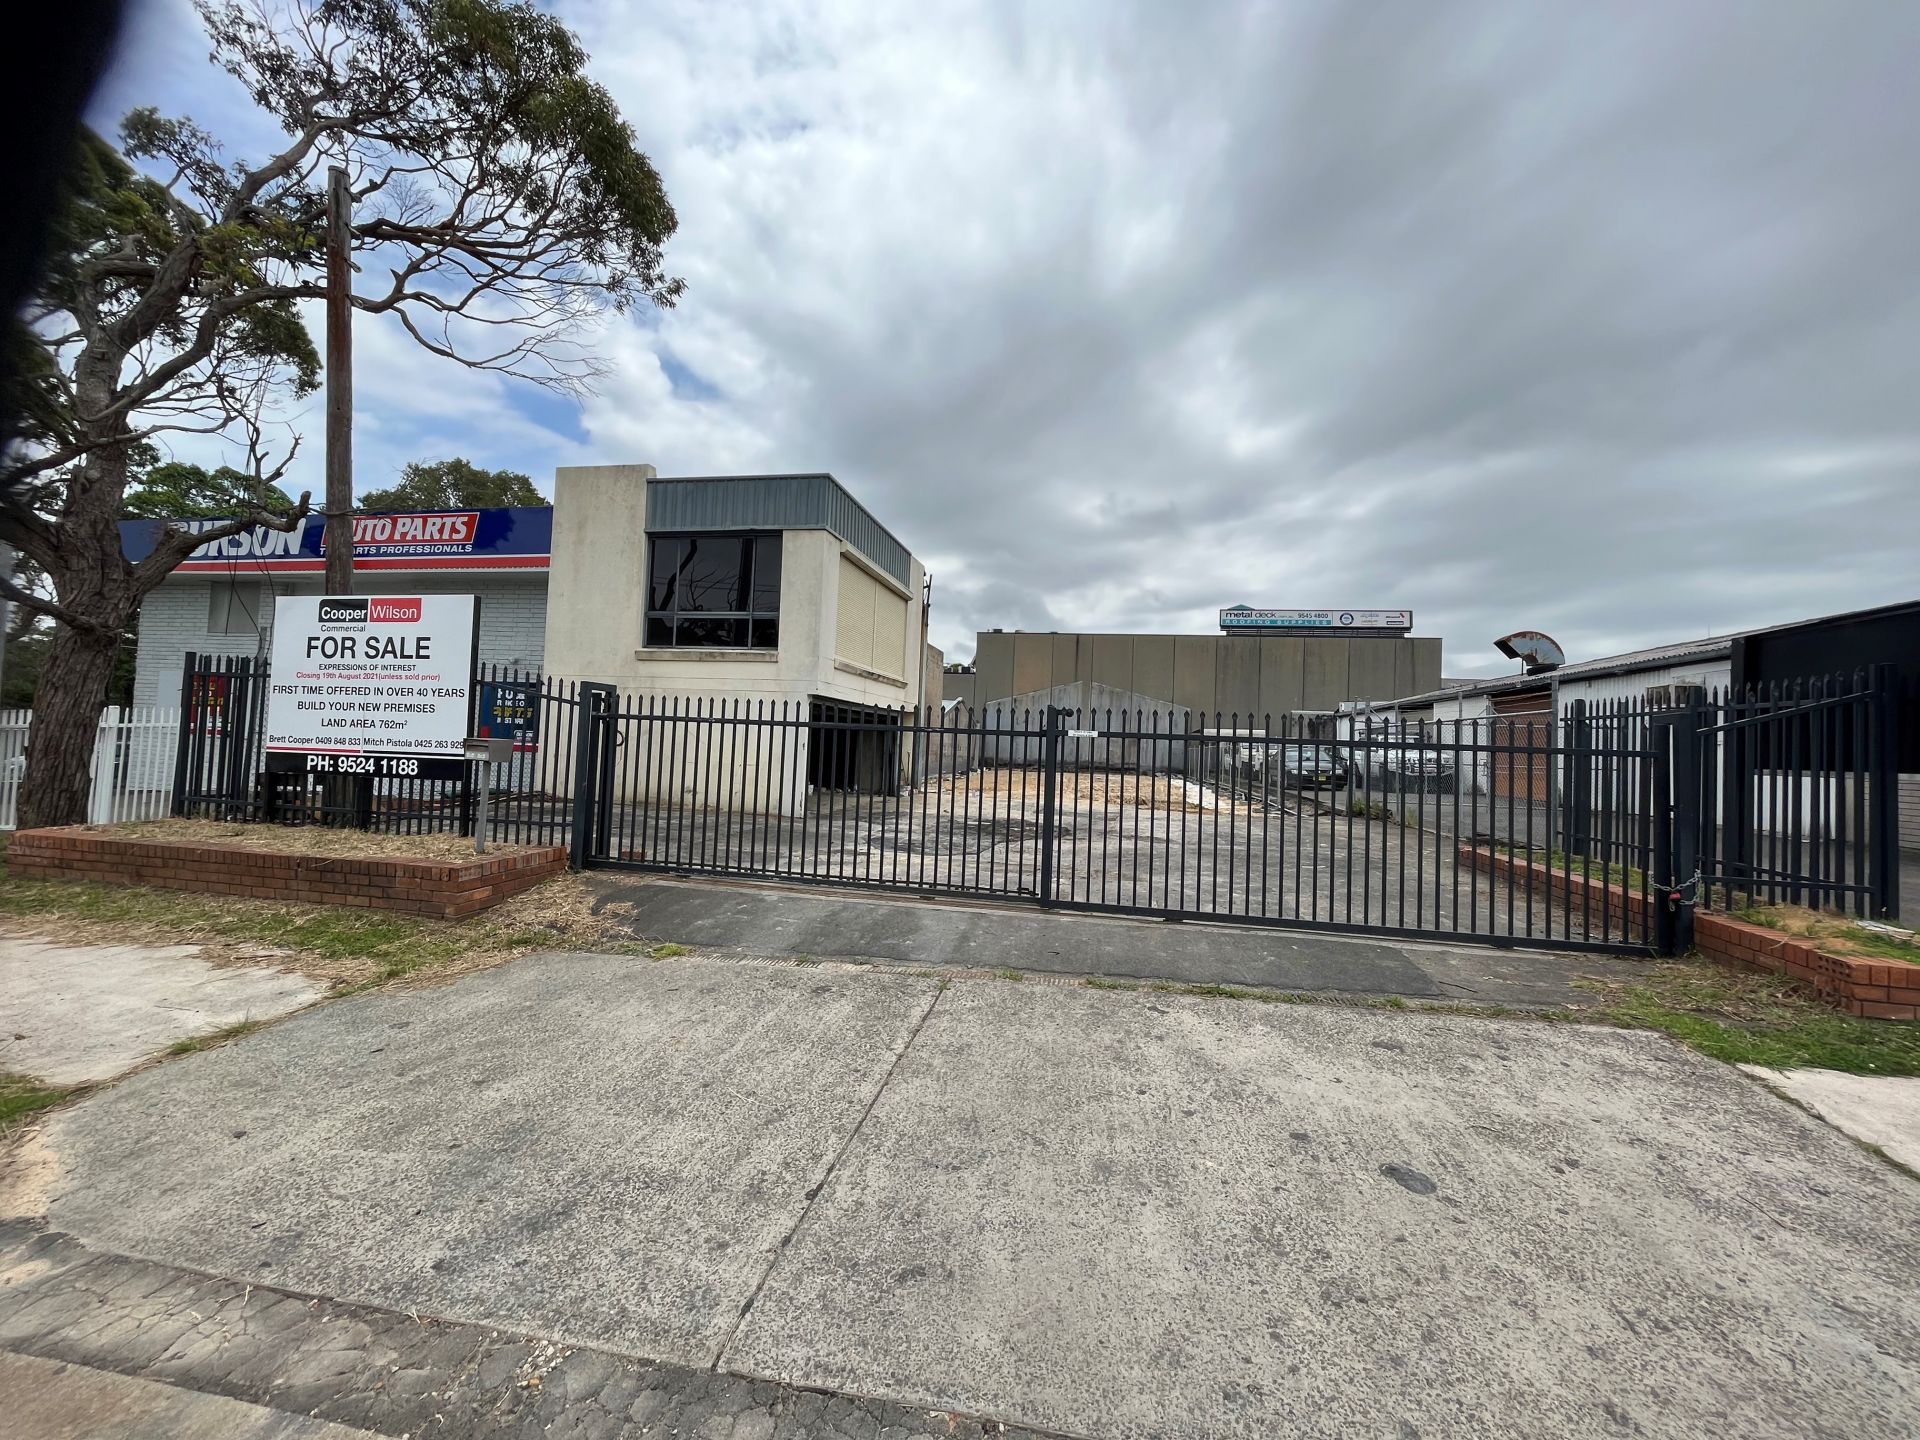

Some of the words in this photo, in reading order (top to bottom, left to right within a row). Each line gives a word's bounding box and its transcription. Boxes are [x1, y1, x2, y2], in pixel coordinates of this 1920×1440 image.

[343, 518, 392, 542] UTO
[394, 516, 469, 540] PARTS
[170, 517, 306, 557] URSON
[351, 546, 376, 556] ARTS
[380, 544, 473, 554] PROFESSIONALS
[321, 607, 367, 621] Cooper
[372, 606, 417, 619] Wilson
[307, 636, 357, 659] FOR
[365, 636, 431, 659] SALE
[338, 672, 361, 680] August
[421, 674, 440, 682] prior)
[273, 686, 299, 694] FIRST
[302, 686, 324, 694] TIME
[327, 687, 370, 695] OFFERED
[374, 687, 383, 695] IN
[387, 687, 413, 696] OVER
[417, 688, 428, 696] 40
[431, 689, 465, 697] YEARS
[297, 702, 325, 710] BUILD
[329, 702, 355, 711] YOUR
[358, 703, 381, 712] NEW
[384, 704, 435, 713] PREMISES
[321, 719, 346, 727] LAND
[350, 719, 375, 728] AREA
[269, 735, 286, 743] Brett
[288, 736, 314, 745] Cooper
[364, 738, 384, 746] Mitch
[387, 739, 412, 747] Pistola
[307, 756, 334, 771] PH:
[338, 757, 374, 773] 9524
[381, 759, 418, 775] 1188
